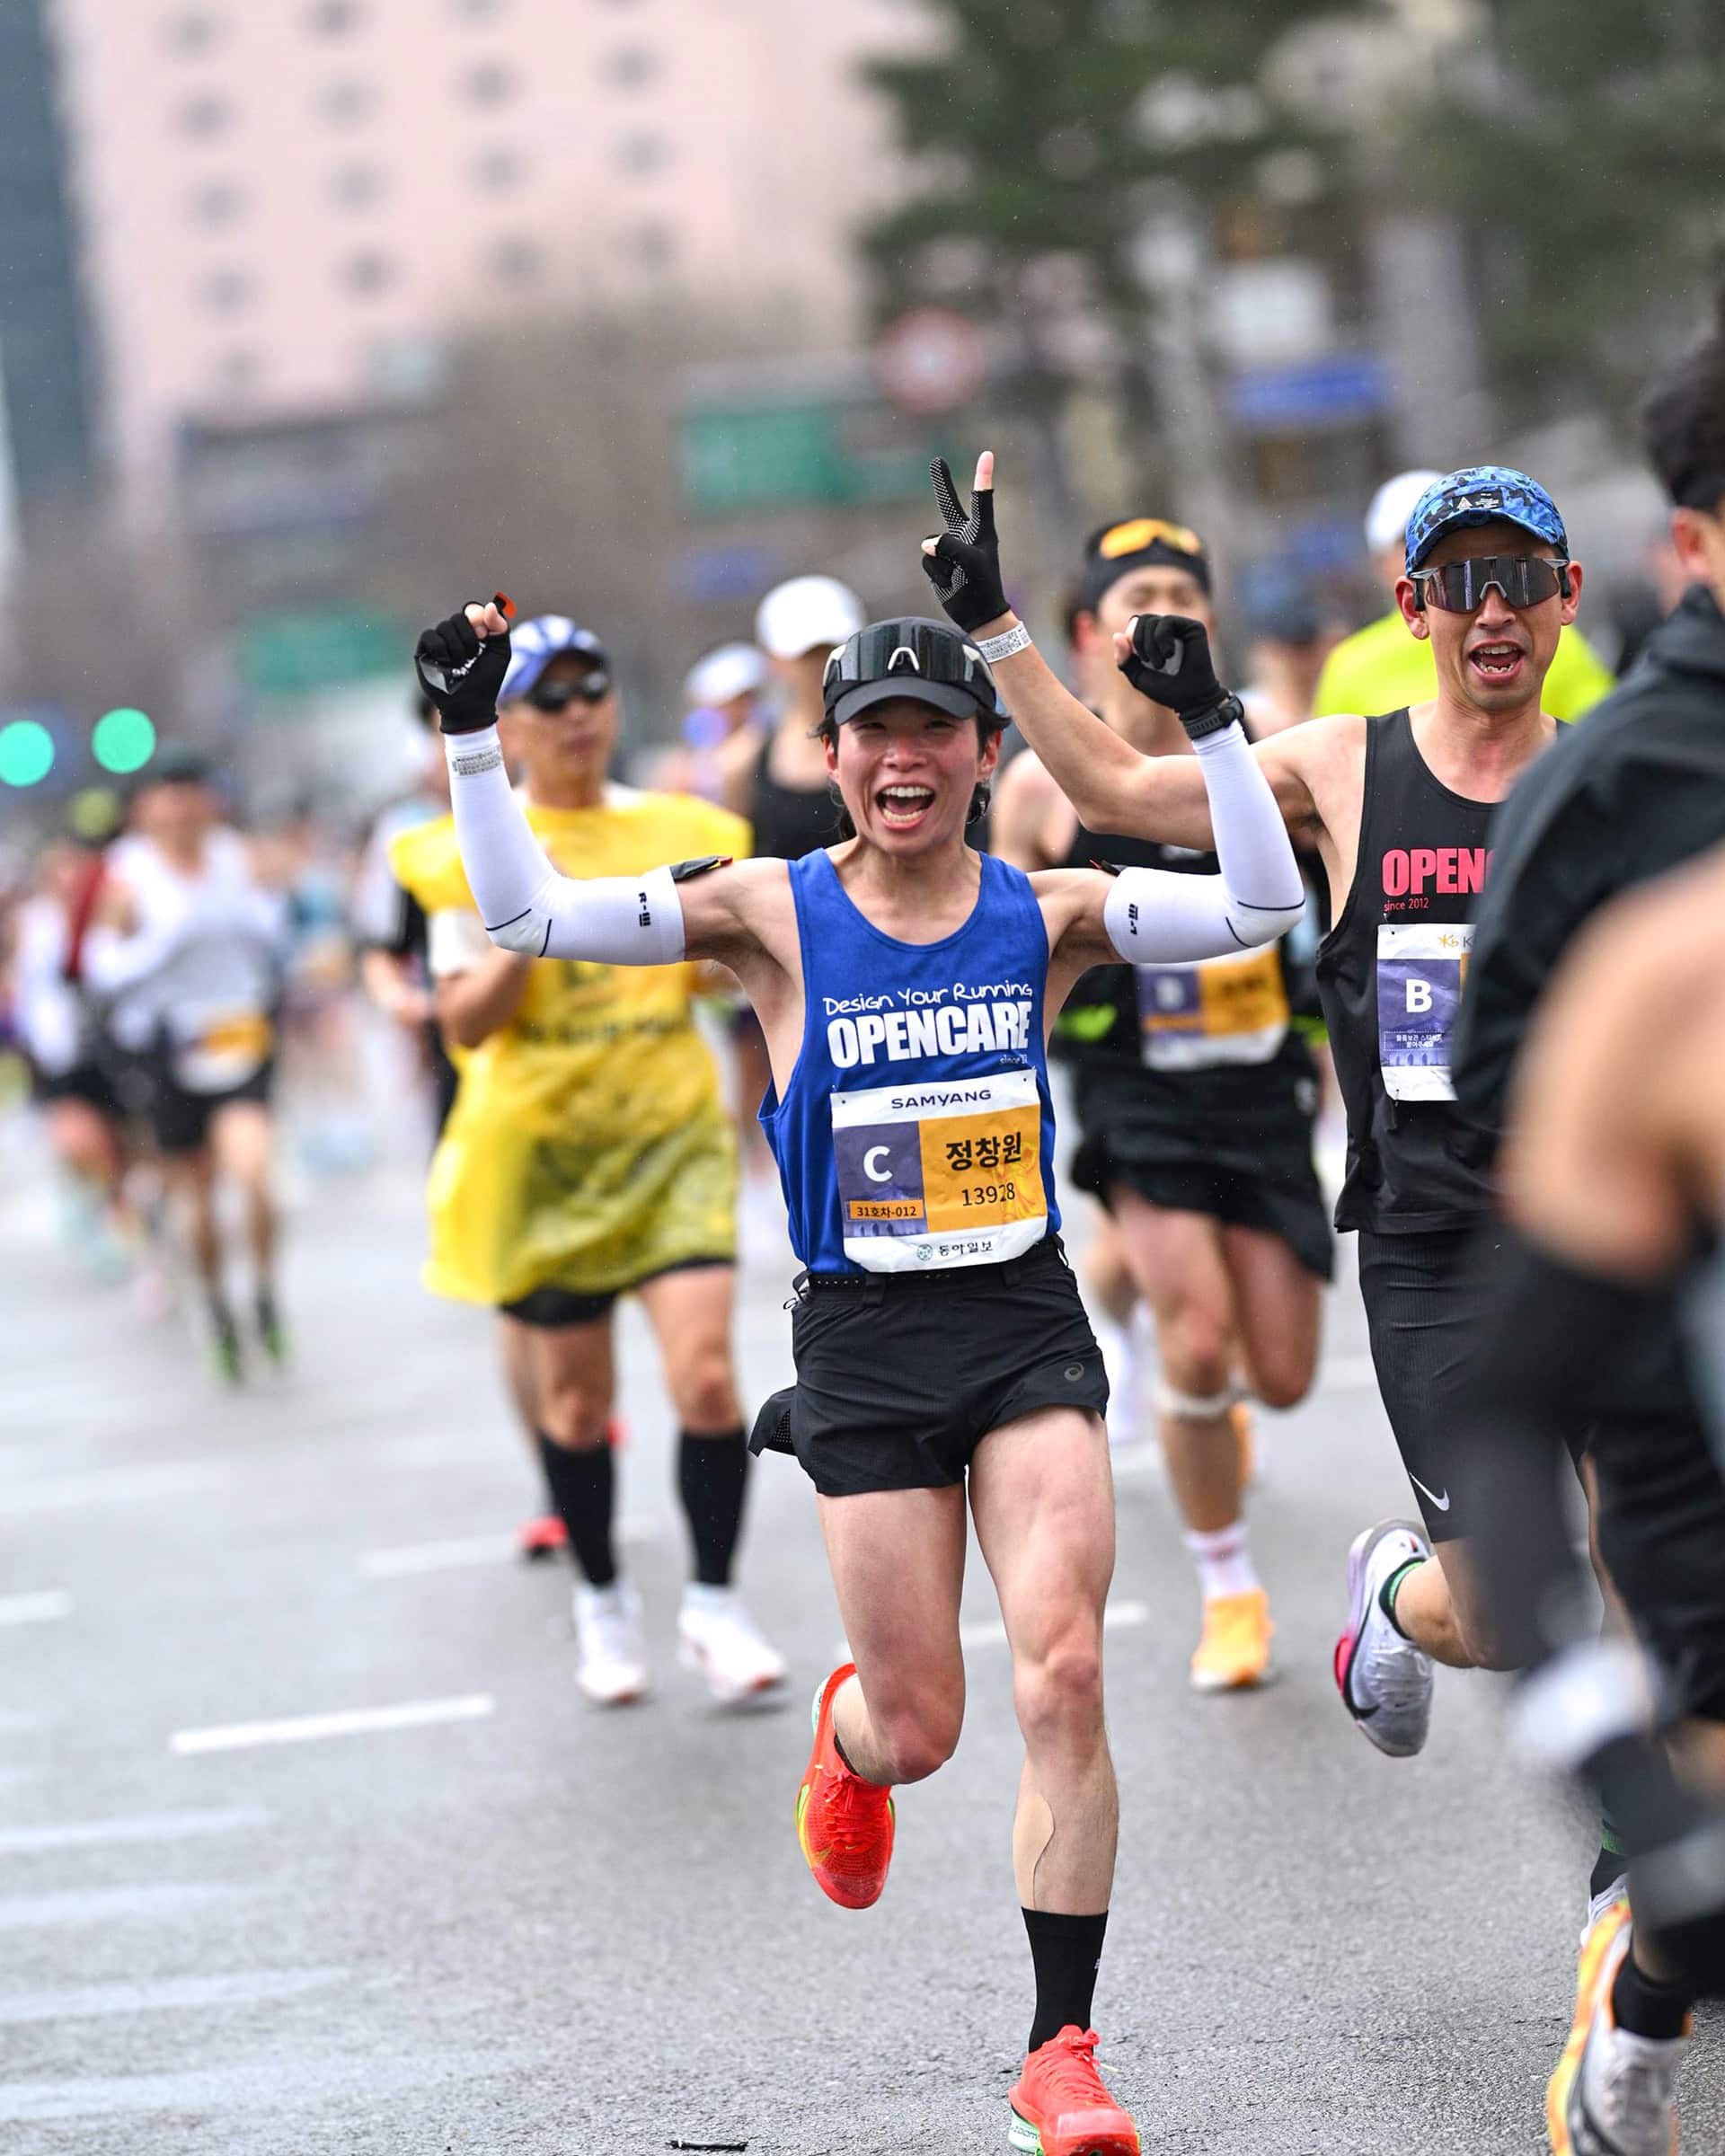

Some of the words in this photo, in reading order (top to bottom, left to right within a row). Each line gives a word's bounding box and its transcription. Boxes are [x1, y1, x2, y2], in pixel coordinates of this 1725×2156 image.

[1384, 899, 1405, 912] since
[1409, 897, 1429, 910] 2012
[822, 993, 894, 1016] Design
[897, 987, 949, 1007] Your
[953, 979, 1033, 1003] Running
[1406, 978, 1433, 1012] B
[827, 1001, 1032, 1069] OPENCARE
[891, 1090, 992, 1109] SAMYANG
[862, 1144, 893, 1183] C
[946, 1131, 1022, 1171] 정창원
[856, 1205, 916, 1218] 31호차-012
[938, 1241, 994, 1257] 동아일보
